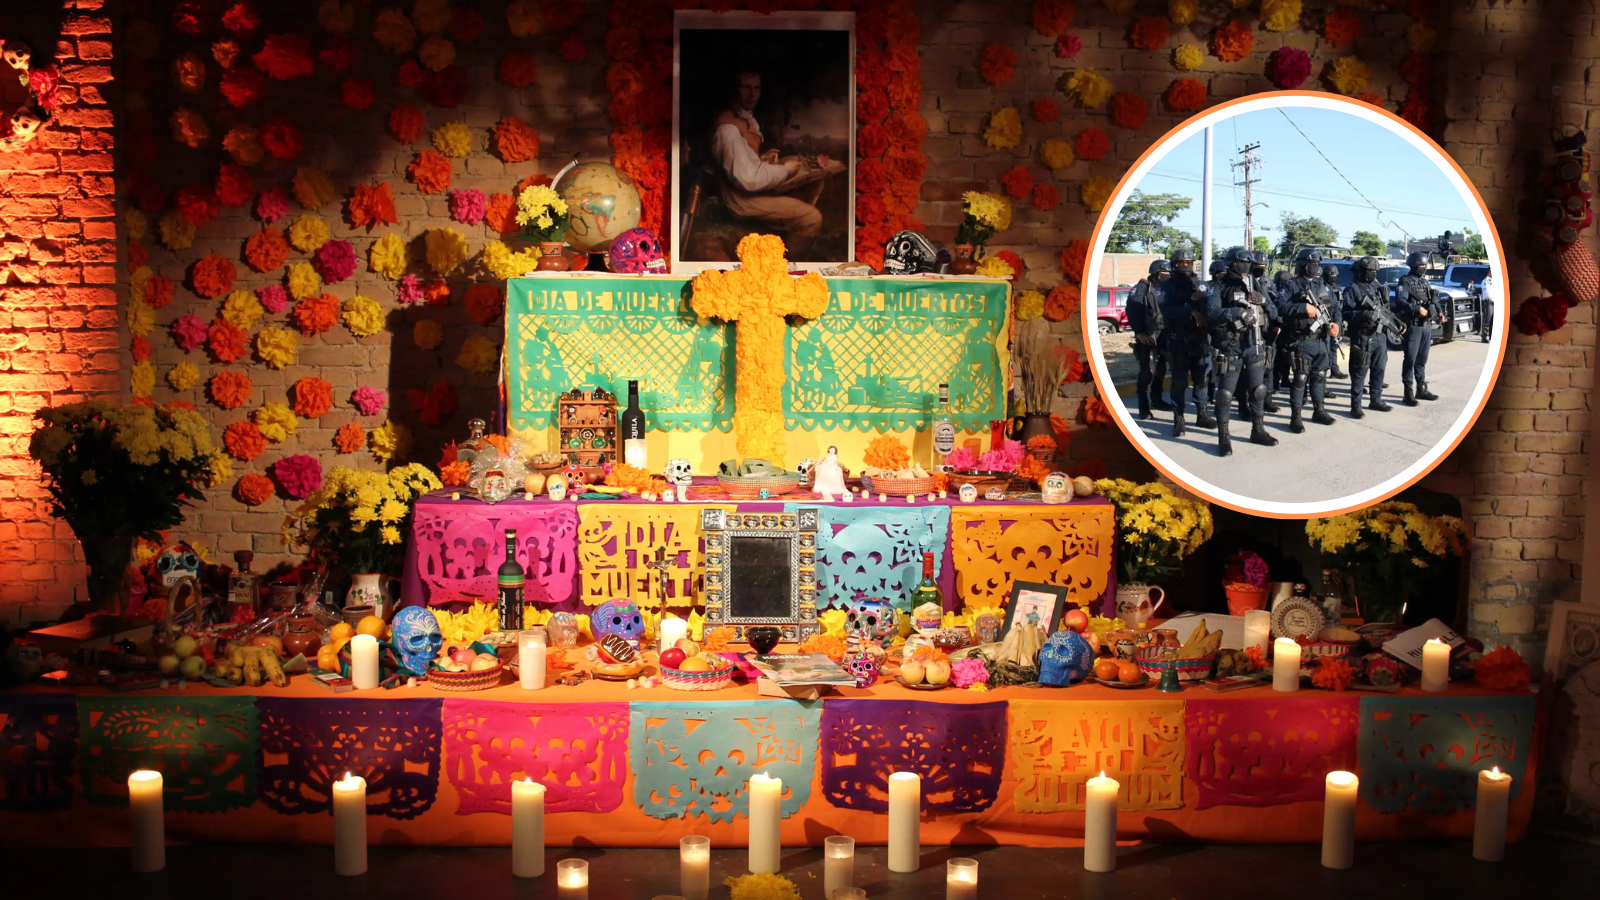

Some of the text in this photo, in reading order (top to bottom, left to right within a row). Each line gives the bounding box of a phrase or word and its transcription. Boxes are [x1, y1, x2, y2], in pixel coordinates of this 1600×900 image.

[532, 290, 568, 311] DIA
[576, 291, 604, 311] DE
[850, 291, 878, 311] DE
[884, 291, 984, 313] MUERTOS
[631, 417, 639, 440] QUILA
[630, 521, 688, 548] DIA
